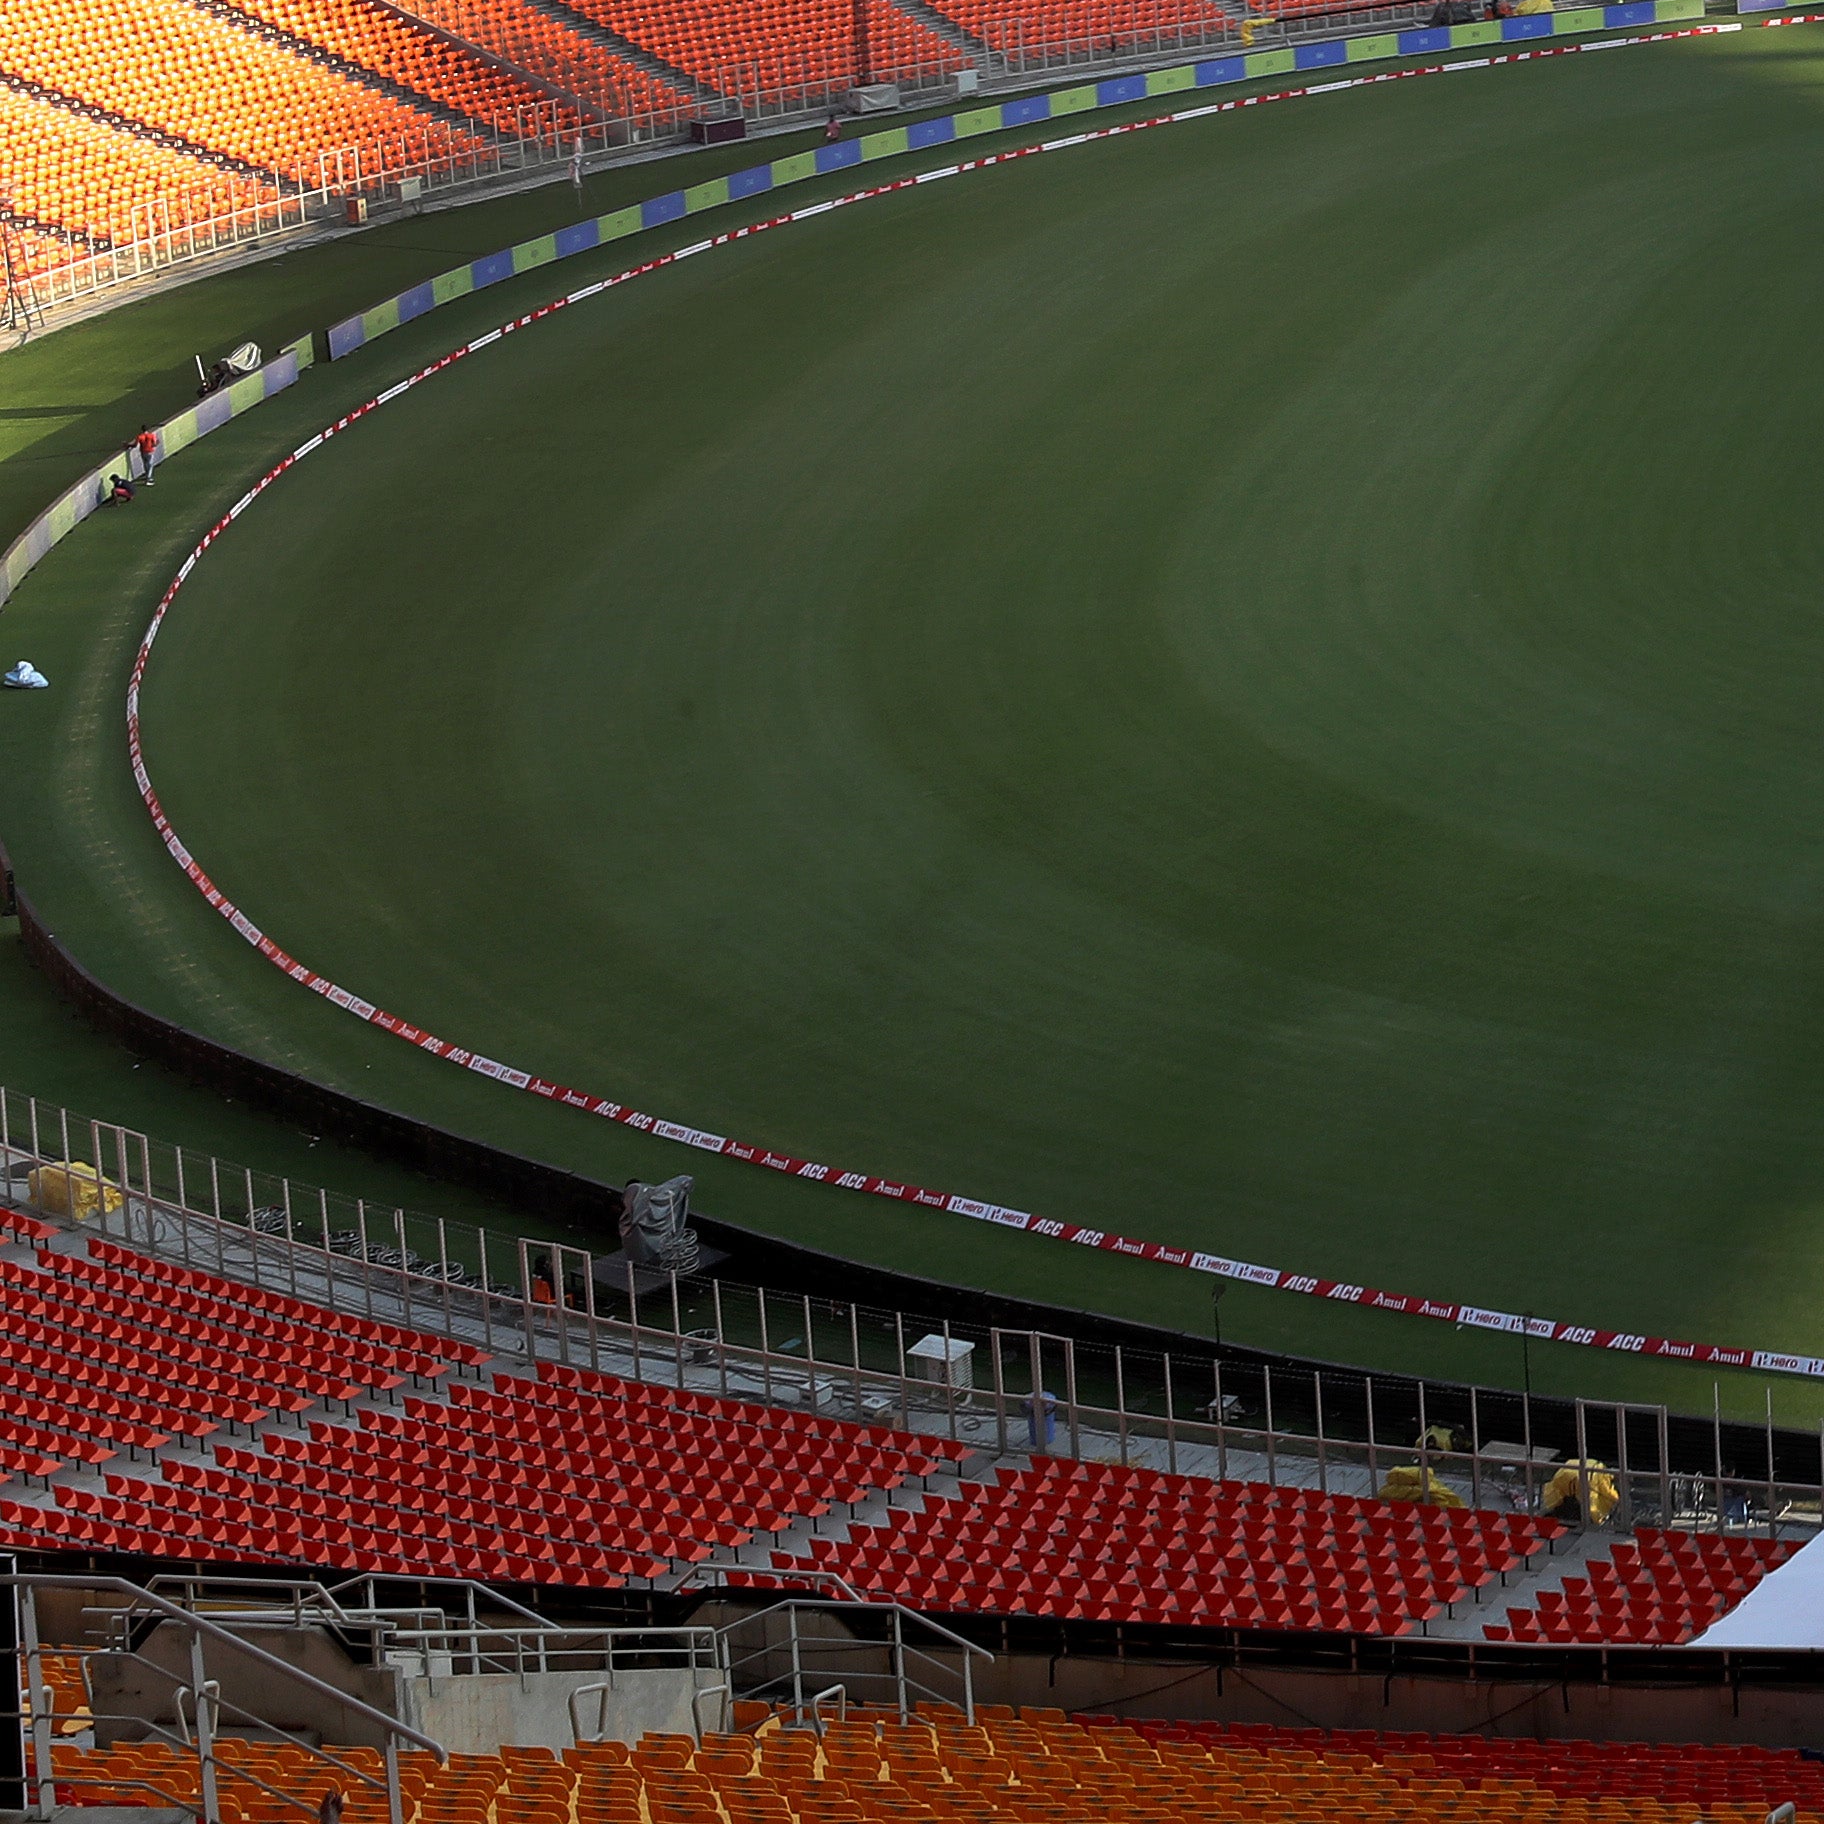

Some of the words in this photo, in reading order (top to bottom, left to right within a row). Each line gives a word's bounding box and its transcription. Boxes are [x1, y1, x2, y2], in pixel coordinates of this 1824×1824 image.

[624, 1112, 653, 1130] ACC
[726, 1141, 755, 1159] Amul
[1419, 1300, 1453, 1319] Amul
[1558, 1325, 1597, 1344] ACC
